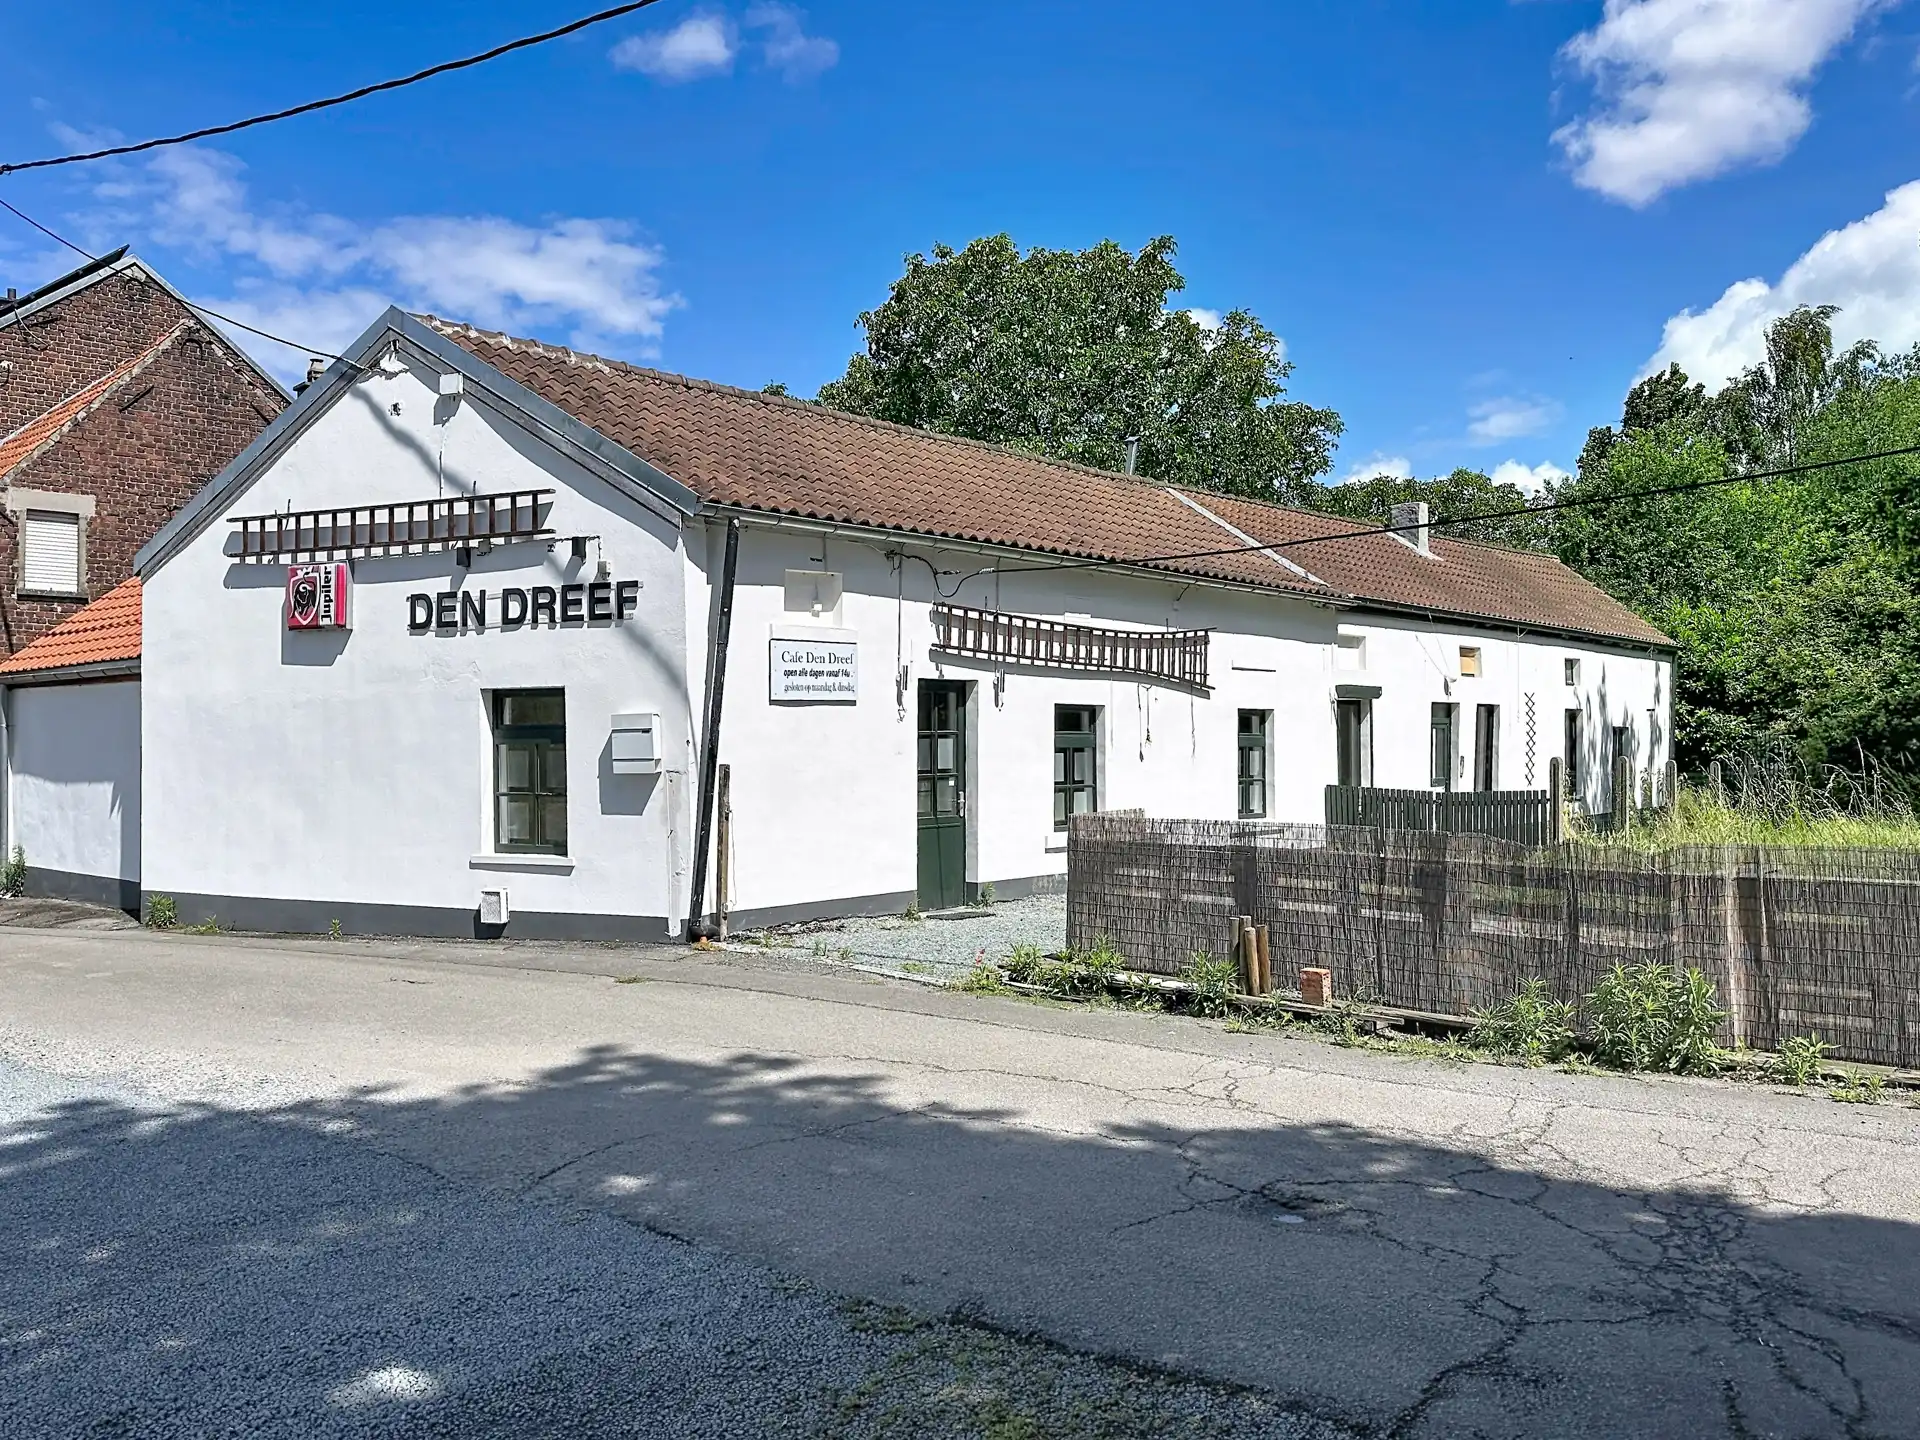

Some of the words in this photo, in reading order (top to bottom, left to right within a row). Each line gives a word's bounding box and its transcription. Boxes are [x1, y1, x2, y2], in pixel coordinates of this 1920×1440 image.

[320, 566, 334, 623] Jupiler
[409, 589, 486, 630] DEN
[500, 580, 639, 626] DREEF
[781, 650, 804, 663] Cafe
[806, 651, 826, 664] Den
[828, 652, 855, 664] Dreef
[783, 669, 798, 679] open
[798, 668, 808, 677] alle
[809, 668, 825, 679] dagen
[826, 668, 841, 678] vanaf
[784, 681, 804, 693] gesloten
[804, 684, 811, 694] op
[832, 682, 837, 692] &
